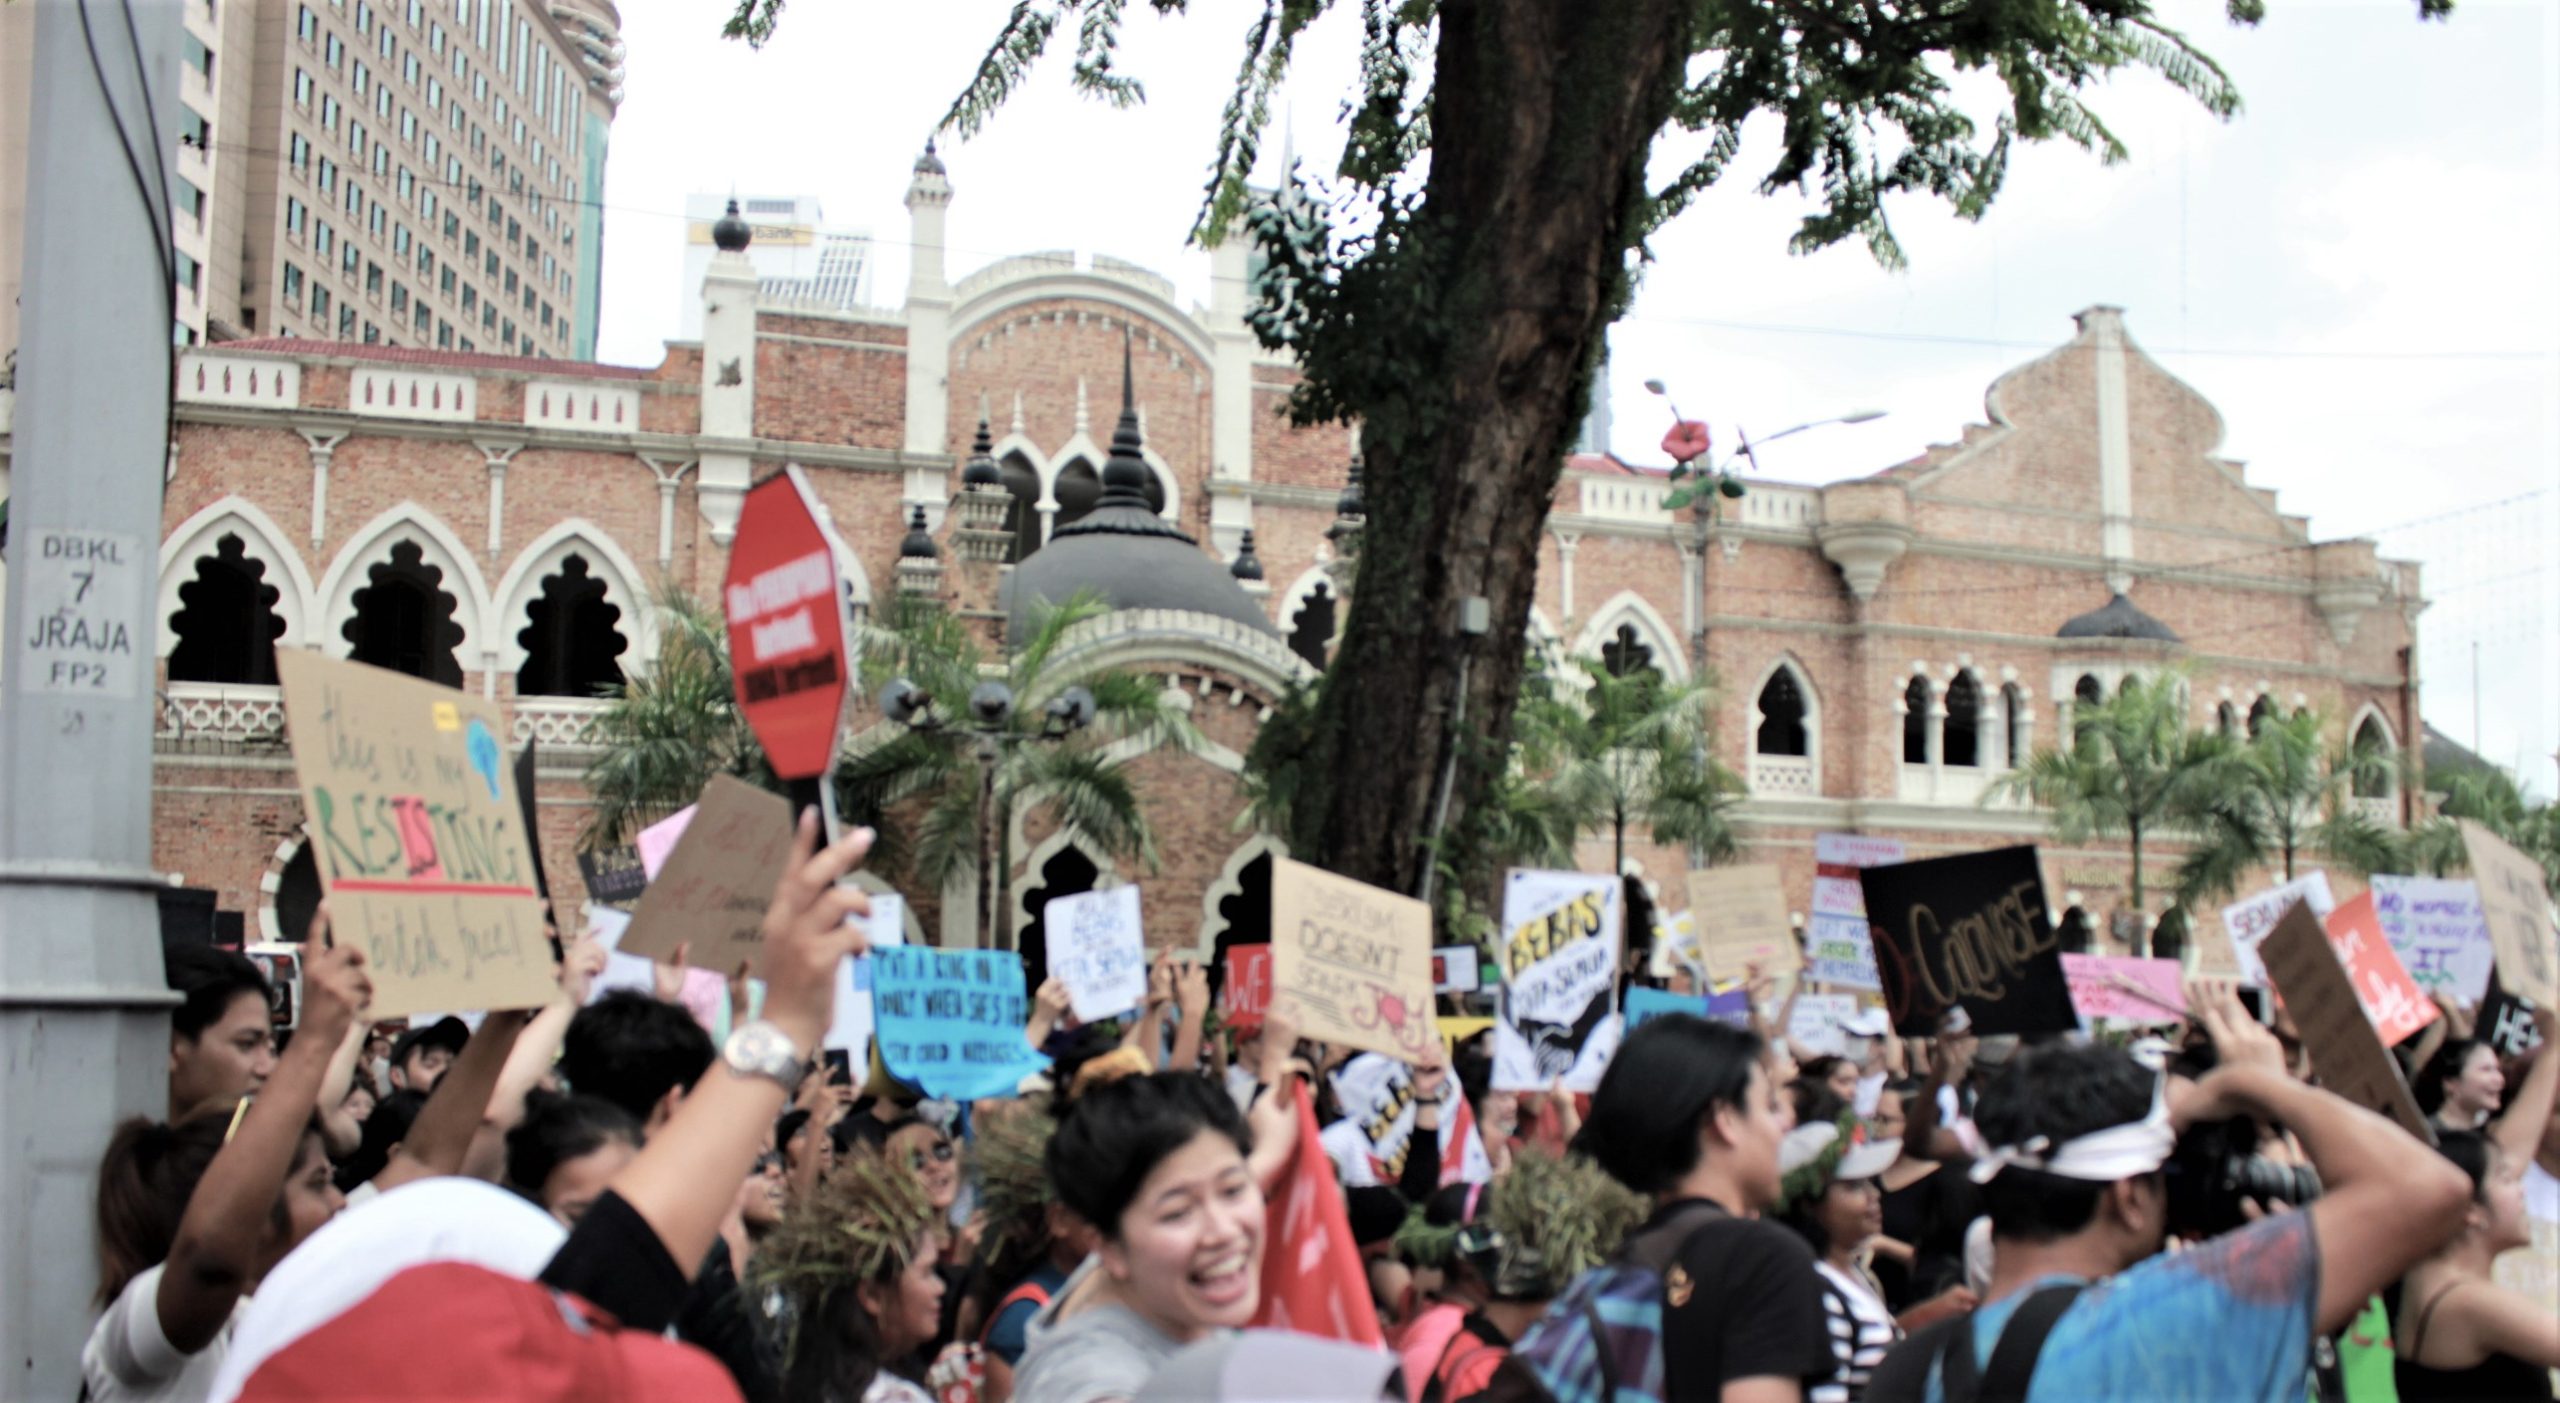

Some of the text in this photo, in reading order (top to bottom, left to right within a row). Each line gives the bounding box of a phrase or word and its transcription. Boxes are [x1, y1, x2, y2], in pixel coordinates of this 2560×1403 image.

[43, 536, 125, 565] DBKL
[71, 572, 95, 604] 7
[50, 661, 108, 688] FP2
[321, 683, 379, 782] this
[393, 728, 420, 783] is
[313, 786, 519, 884] RESISTING
[1509, 889, 1602, 981] BEBAS
[1553, 946, 1610, 997] SEMUA
[924, 988, 963, 1019] WHEN
